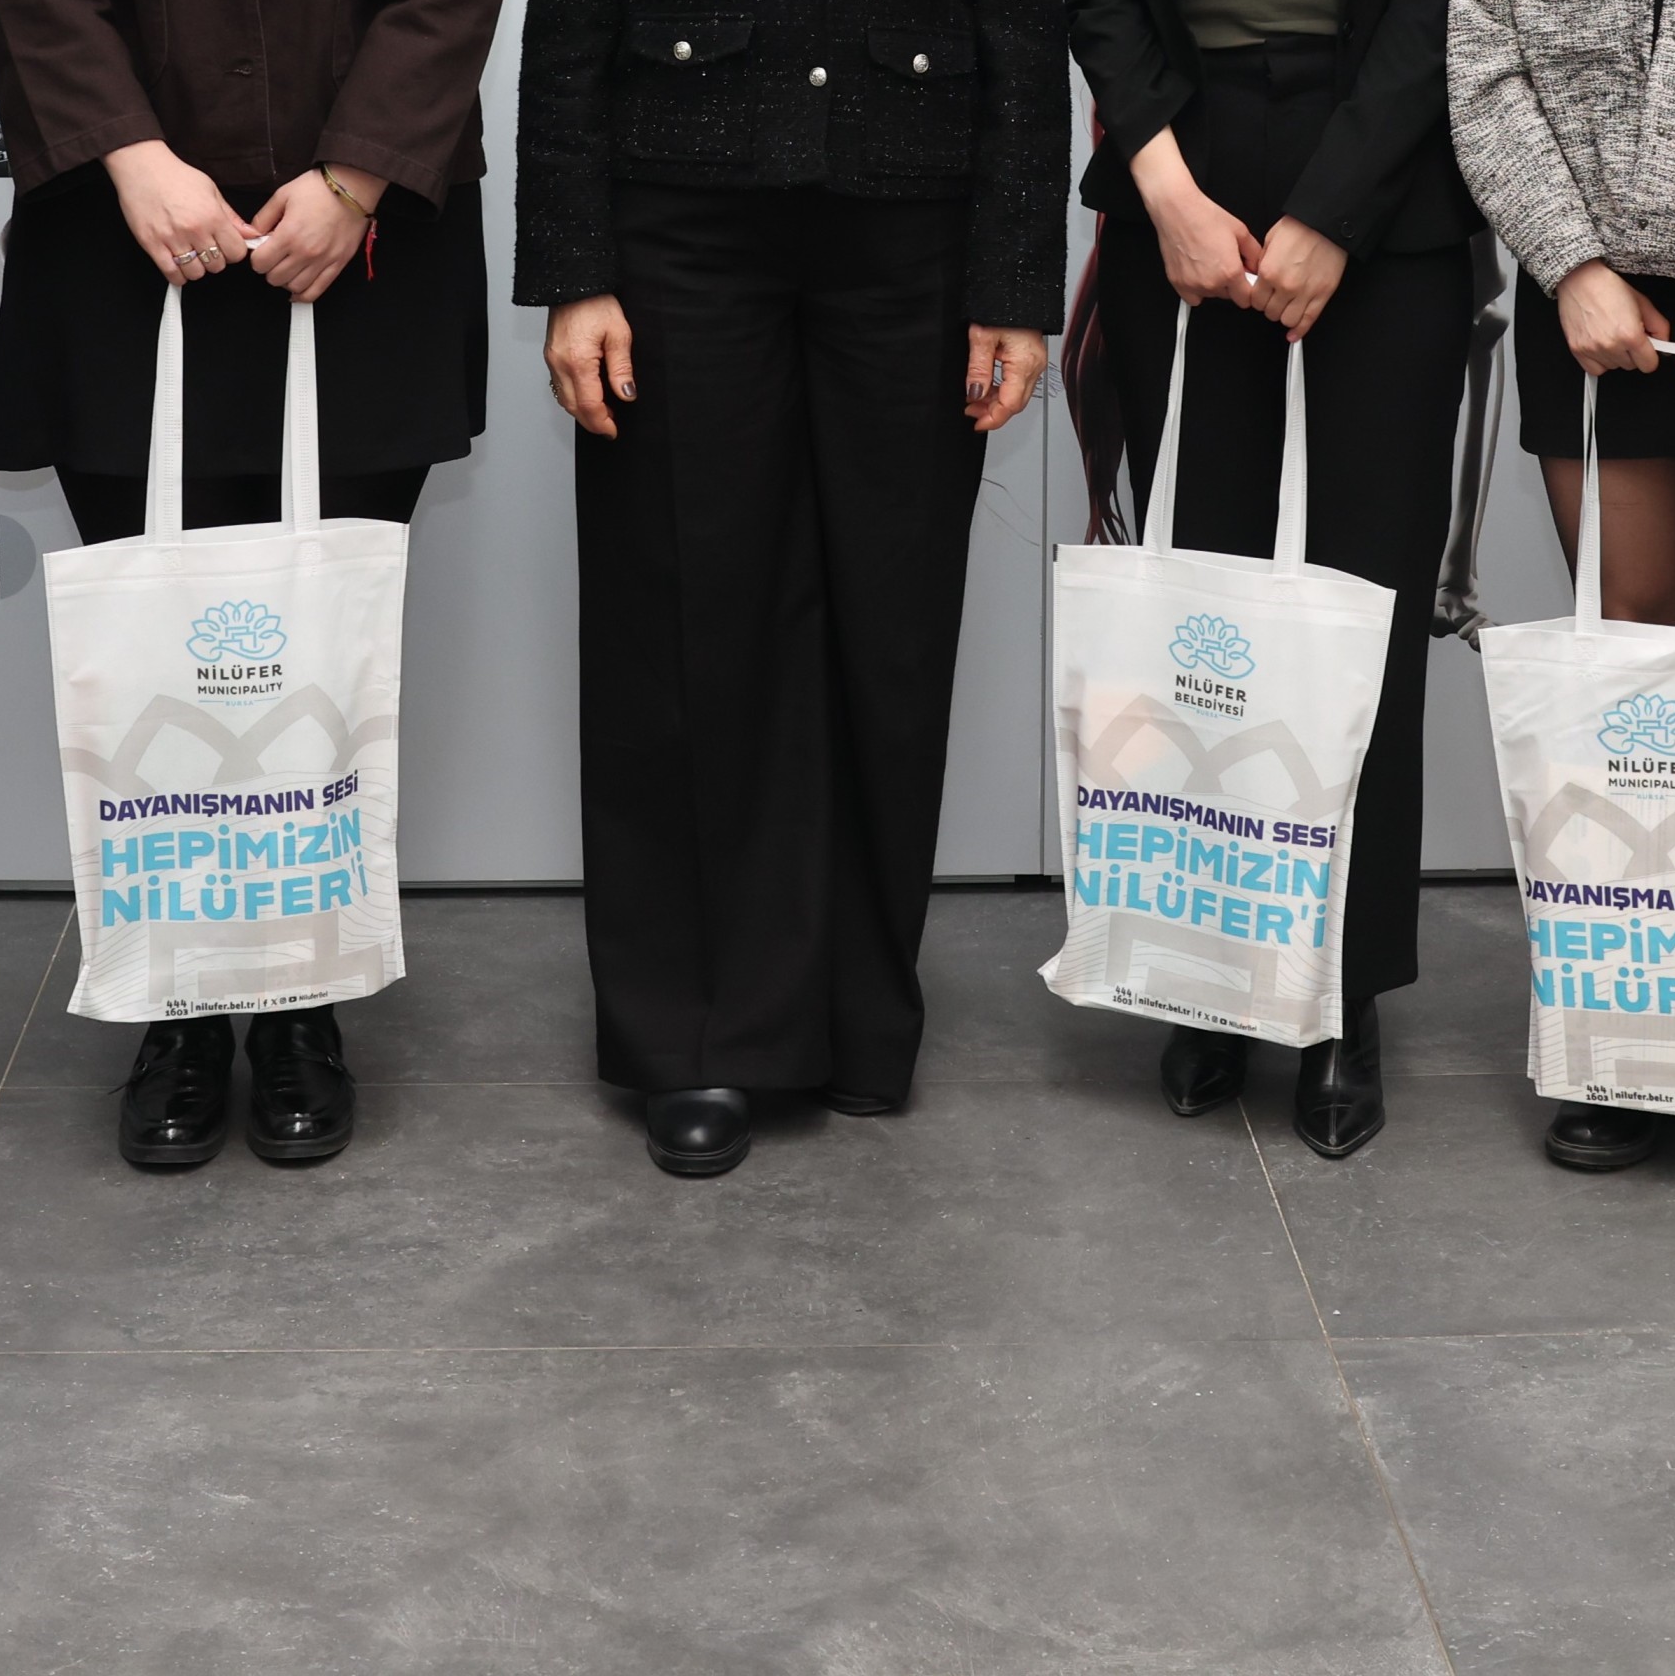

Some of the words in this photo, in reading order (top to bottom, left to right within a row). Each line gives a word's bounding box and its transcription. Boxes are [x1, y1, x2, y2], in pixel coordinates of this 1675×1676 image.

[197, 662, 283, 681] NİLÜFER
[197, 680, 283, 696] MUNICIPALITY
[1175, 673, 1248, 704] NİLÜFER
[225, 699, 255, 707] BURSA
[1174, 690, 1245, 719] BELEDİYESİ
[99, 787, 315, 823] DAYANIŞMANIN
[322, 769, 359, 808] SESİ
[1076, 783, 1265, 840] DAYANIŞMANIN
[1271, 822, 1337, 849] SESİ
[101, 806, 362, 878] HEPİMİZİN
[1075, 818, 1331, 901] HEPİMİZİN
[102, 852, 370, 927] NİLÜFER'İ
[165, 1000, 188, 1010] 444
[195, 998, 256, 1012] nilufer.bel.tr
[165, 1008, 189, 1017] 1603
[1111, 994, 1133, 1007] 1603
[1114, 985, 1133, 997] 444
[1138, 995, 1191, 1018] nilufer.bel.tr
[1586, 1083, 1607, 1094] 444
[1615, 1090, 1674, 1105] nilufer.bel.tr
[1586, 1091, 1609, 1103] 1603
